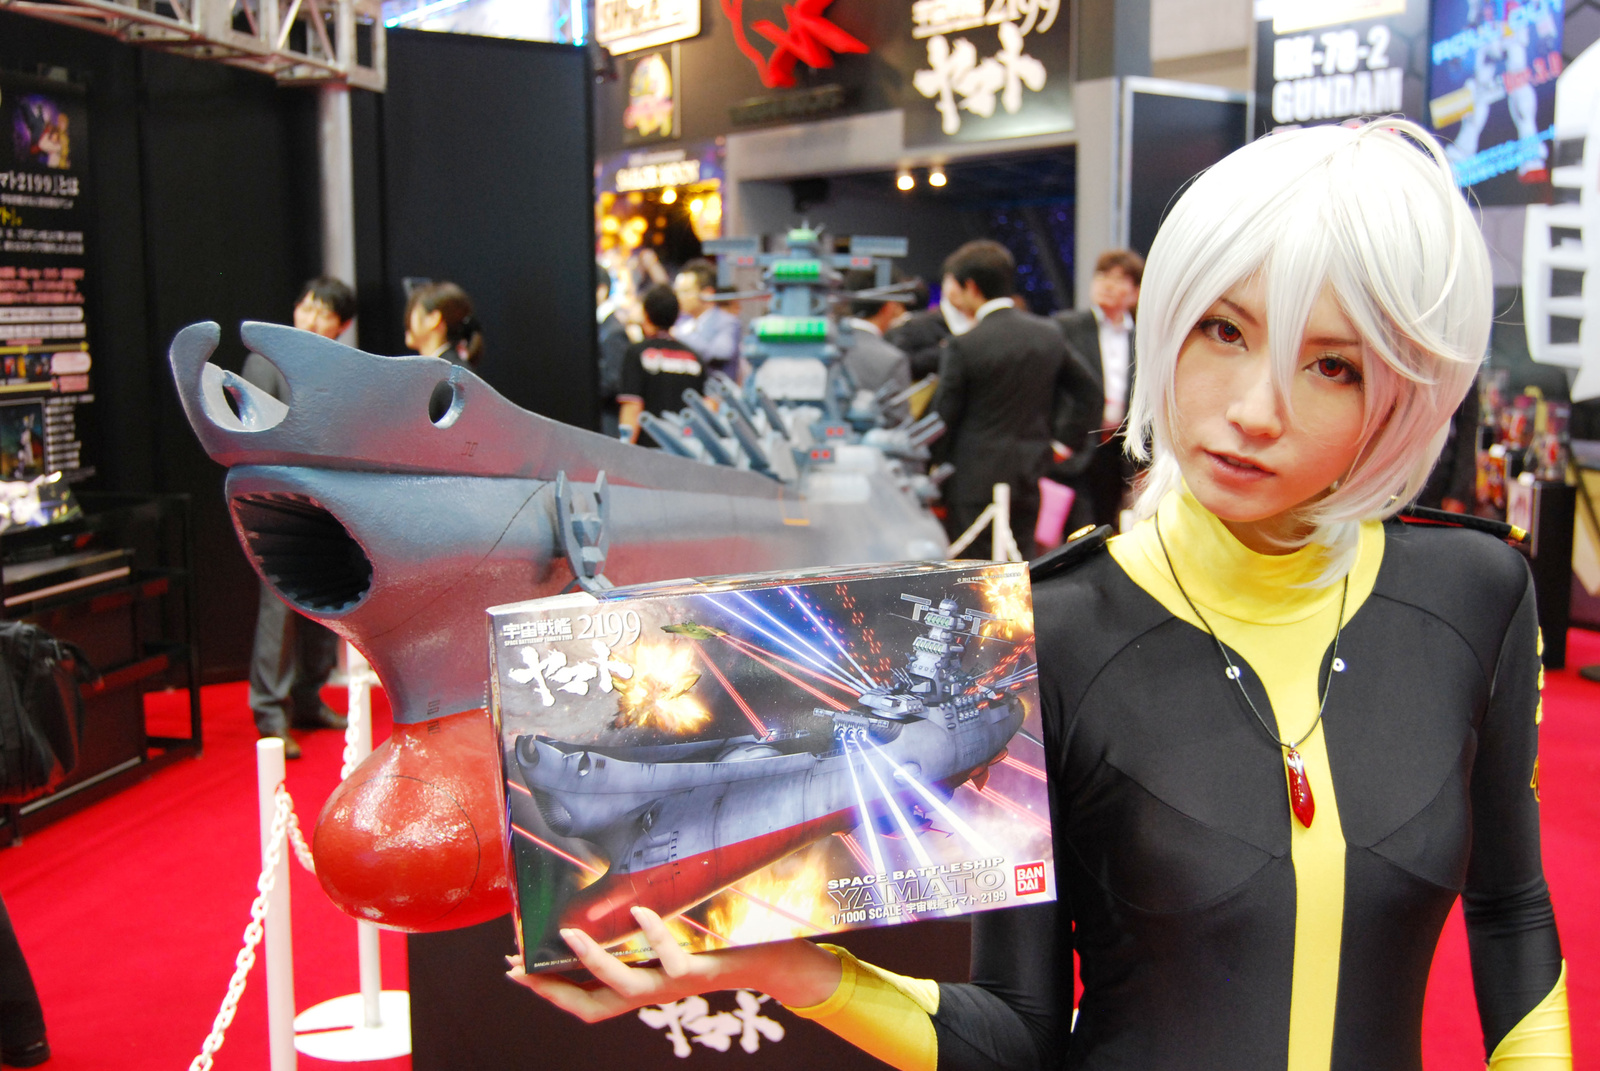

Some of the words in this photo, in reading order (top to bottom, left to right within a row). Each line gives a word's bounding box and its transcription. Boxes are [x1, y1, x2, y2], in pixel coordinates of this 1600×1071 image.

[1271, 67, 1403, 124] GUNDAM
[502, 617, 573, 640] 宇宙戦艦
[577, 609, 643, 648] 2199
[507, 640, 634, 707] ヤマト
[827, 872, 888, 890] SPACE
[893, 857, 1004, 881] BATTLESHIP
[827, 869, 1006, 911] YAMATO
[1016, 866, 1044, 880] BAN
[1017, 878, 1040, 892] DAI
[830, 909, 867, 926] 1/1000
[868, 904, 903, 920] SCALE
[905, 894, 978, 914] 宇宙戦艦ヤマト
[981, 890, 1007, 904] 2199
